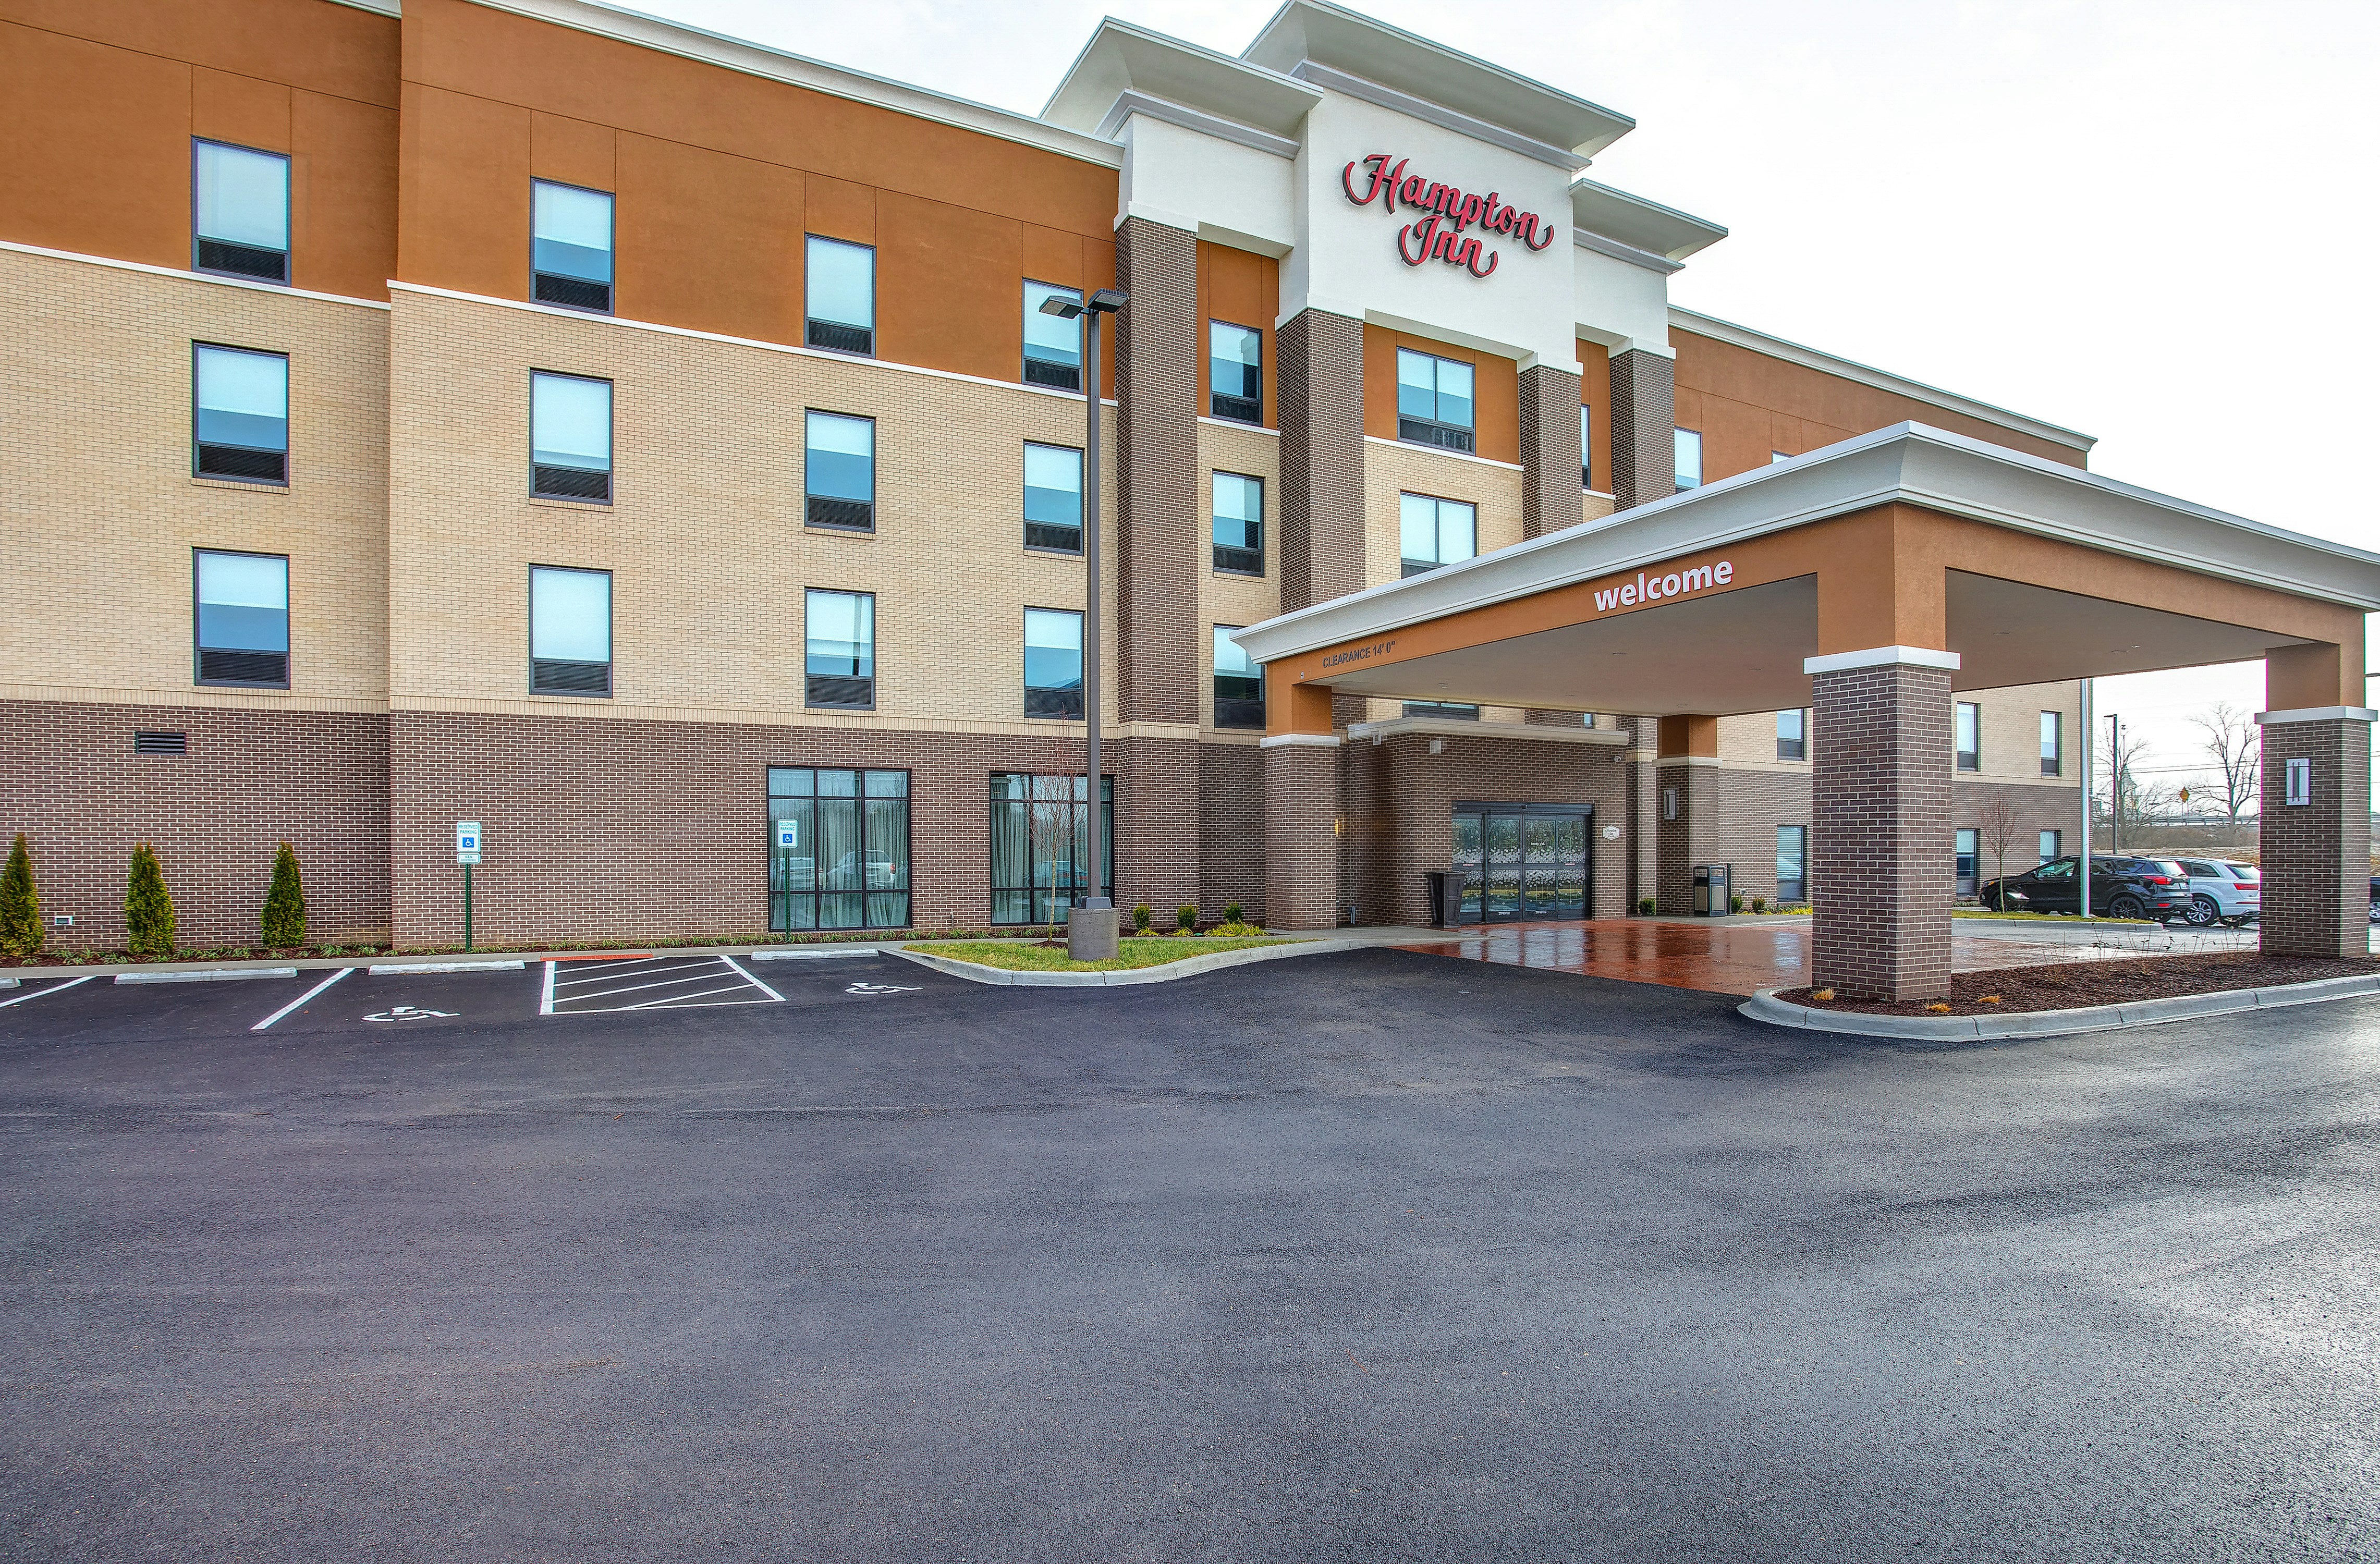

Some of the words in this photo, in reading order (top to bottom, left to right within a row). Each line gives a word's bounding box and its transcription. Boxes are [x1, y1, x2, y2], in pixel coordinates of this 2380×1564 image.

[1342, 154, 1554, 251] Hampton
[1398, 215, 1498, 278] Inn
[1594, 560, 1734, 612] welcome
[1323, 646, 1371, 668] CLEARANCE
